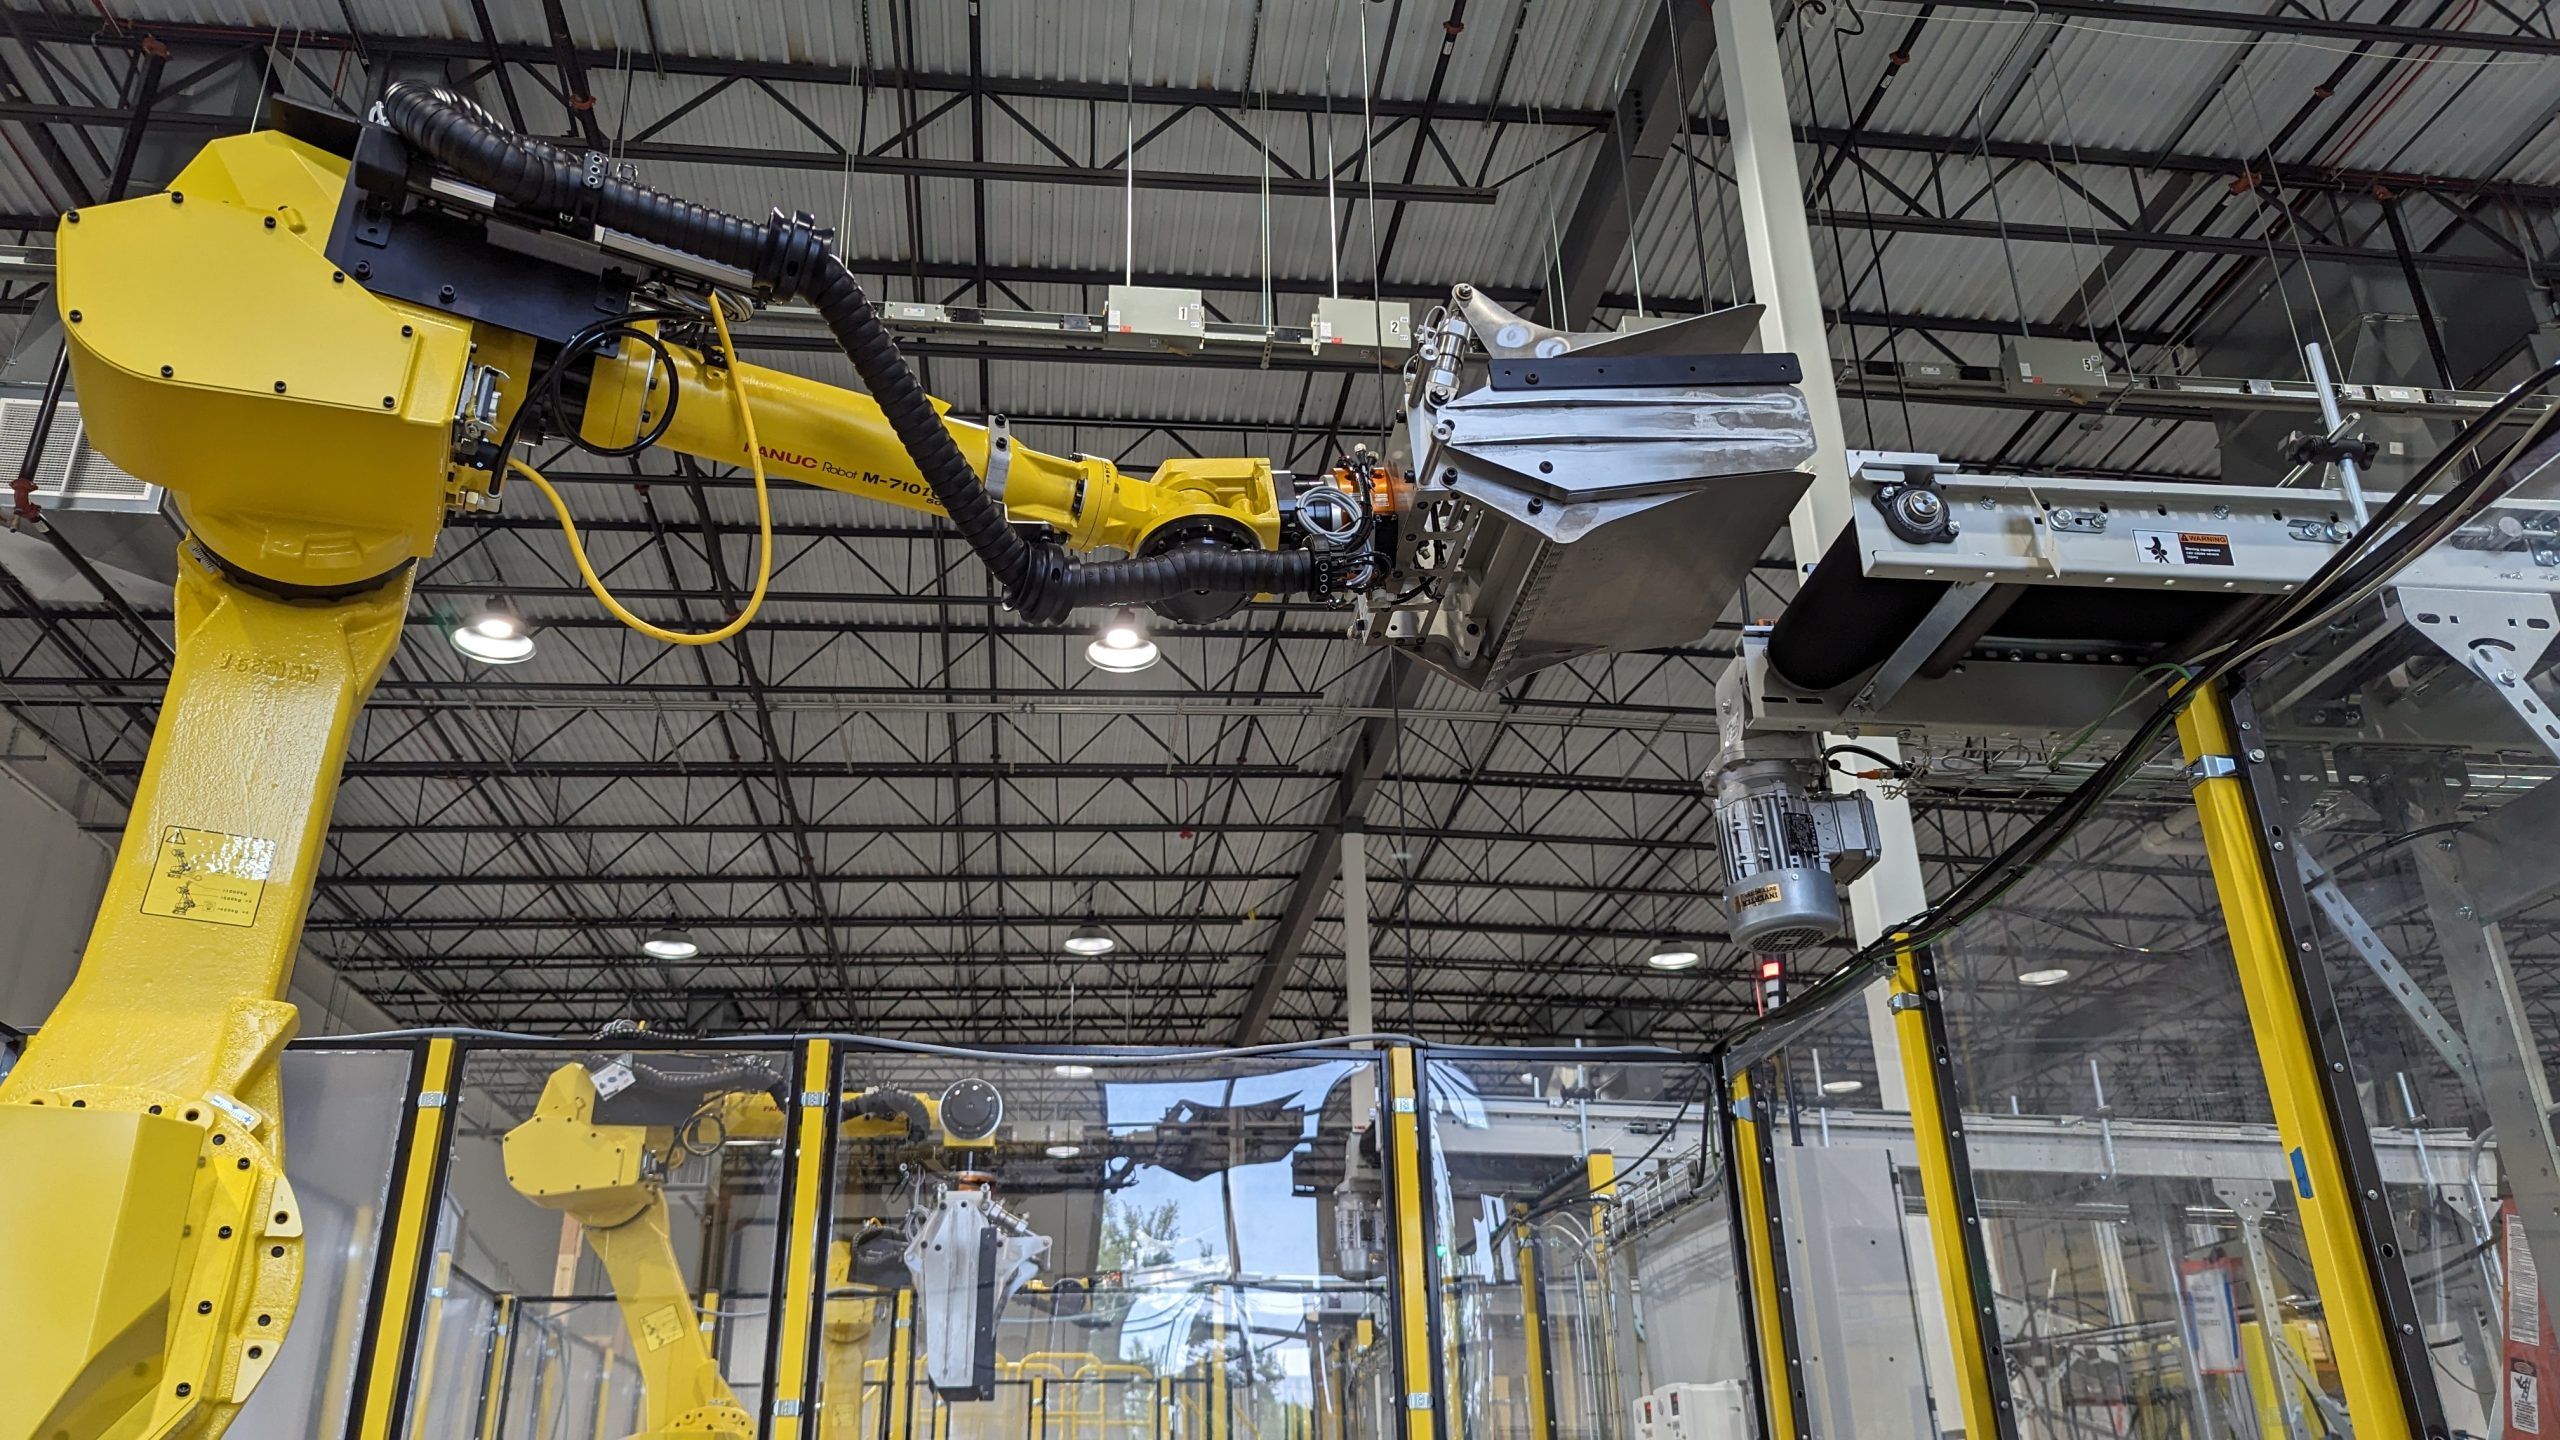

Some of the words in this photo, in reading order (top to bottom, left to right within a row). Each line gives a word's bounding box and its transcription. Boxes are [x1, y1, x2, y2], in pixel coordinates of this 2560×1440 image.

[1181, 308, 1186, 320] 1
[1391, 321, 1398, 333] 2
[2084, 359, 2091, 370] 5
[822, 461, 858, 480] Robot
[2189, 535, 2226, 543] WARNING
